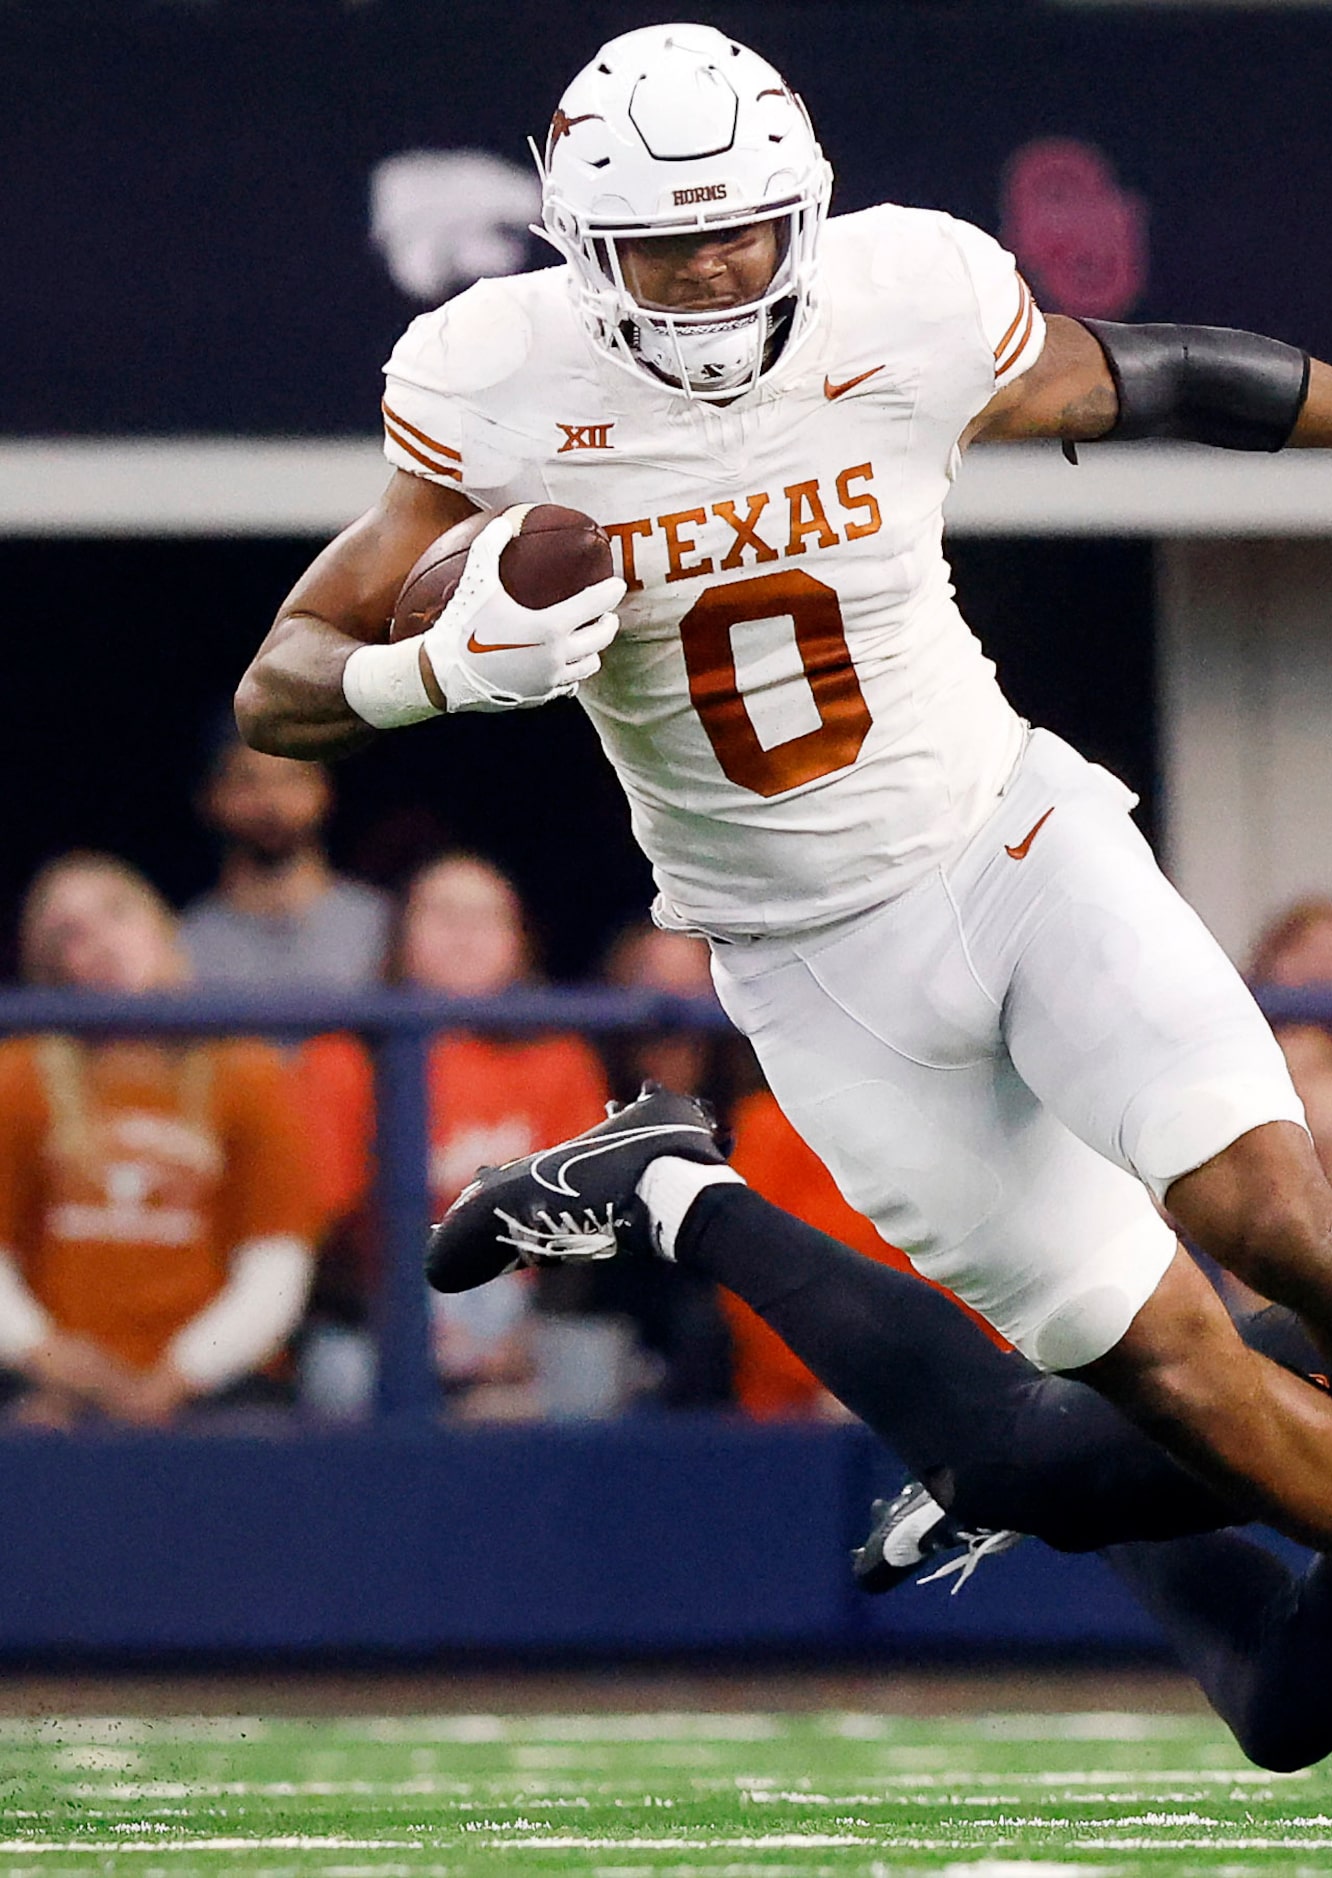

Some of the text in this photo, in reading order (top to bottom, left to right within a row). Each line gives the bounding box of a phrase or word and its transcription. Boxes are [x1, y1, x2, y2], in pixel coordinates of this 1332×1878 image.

[672, 184, 727, 206] HORNS
[600, 462, 882, 590] TEXAS
[679, 568, 873, 798] 0
